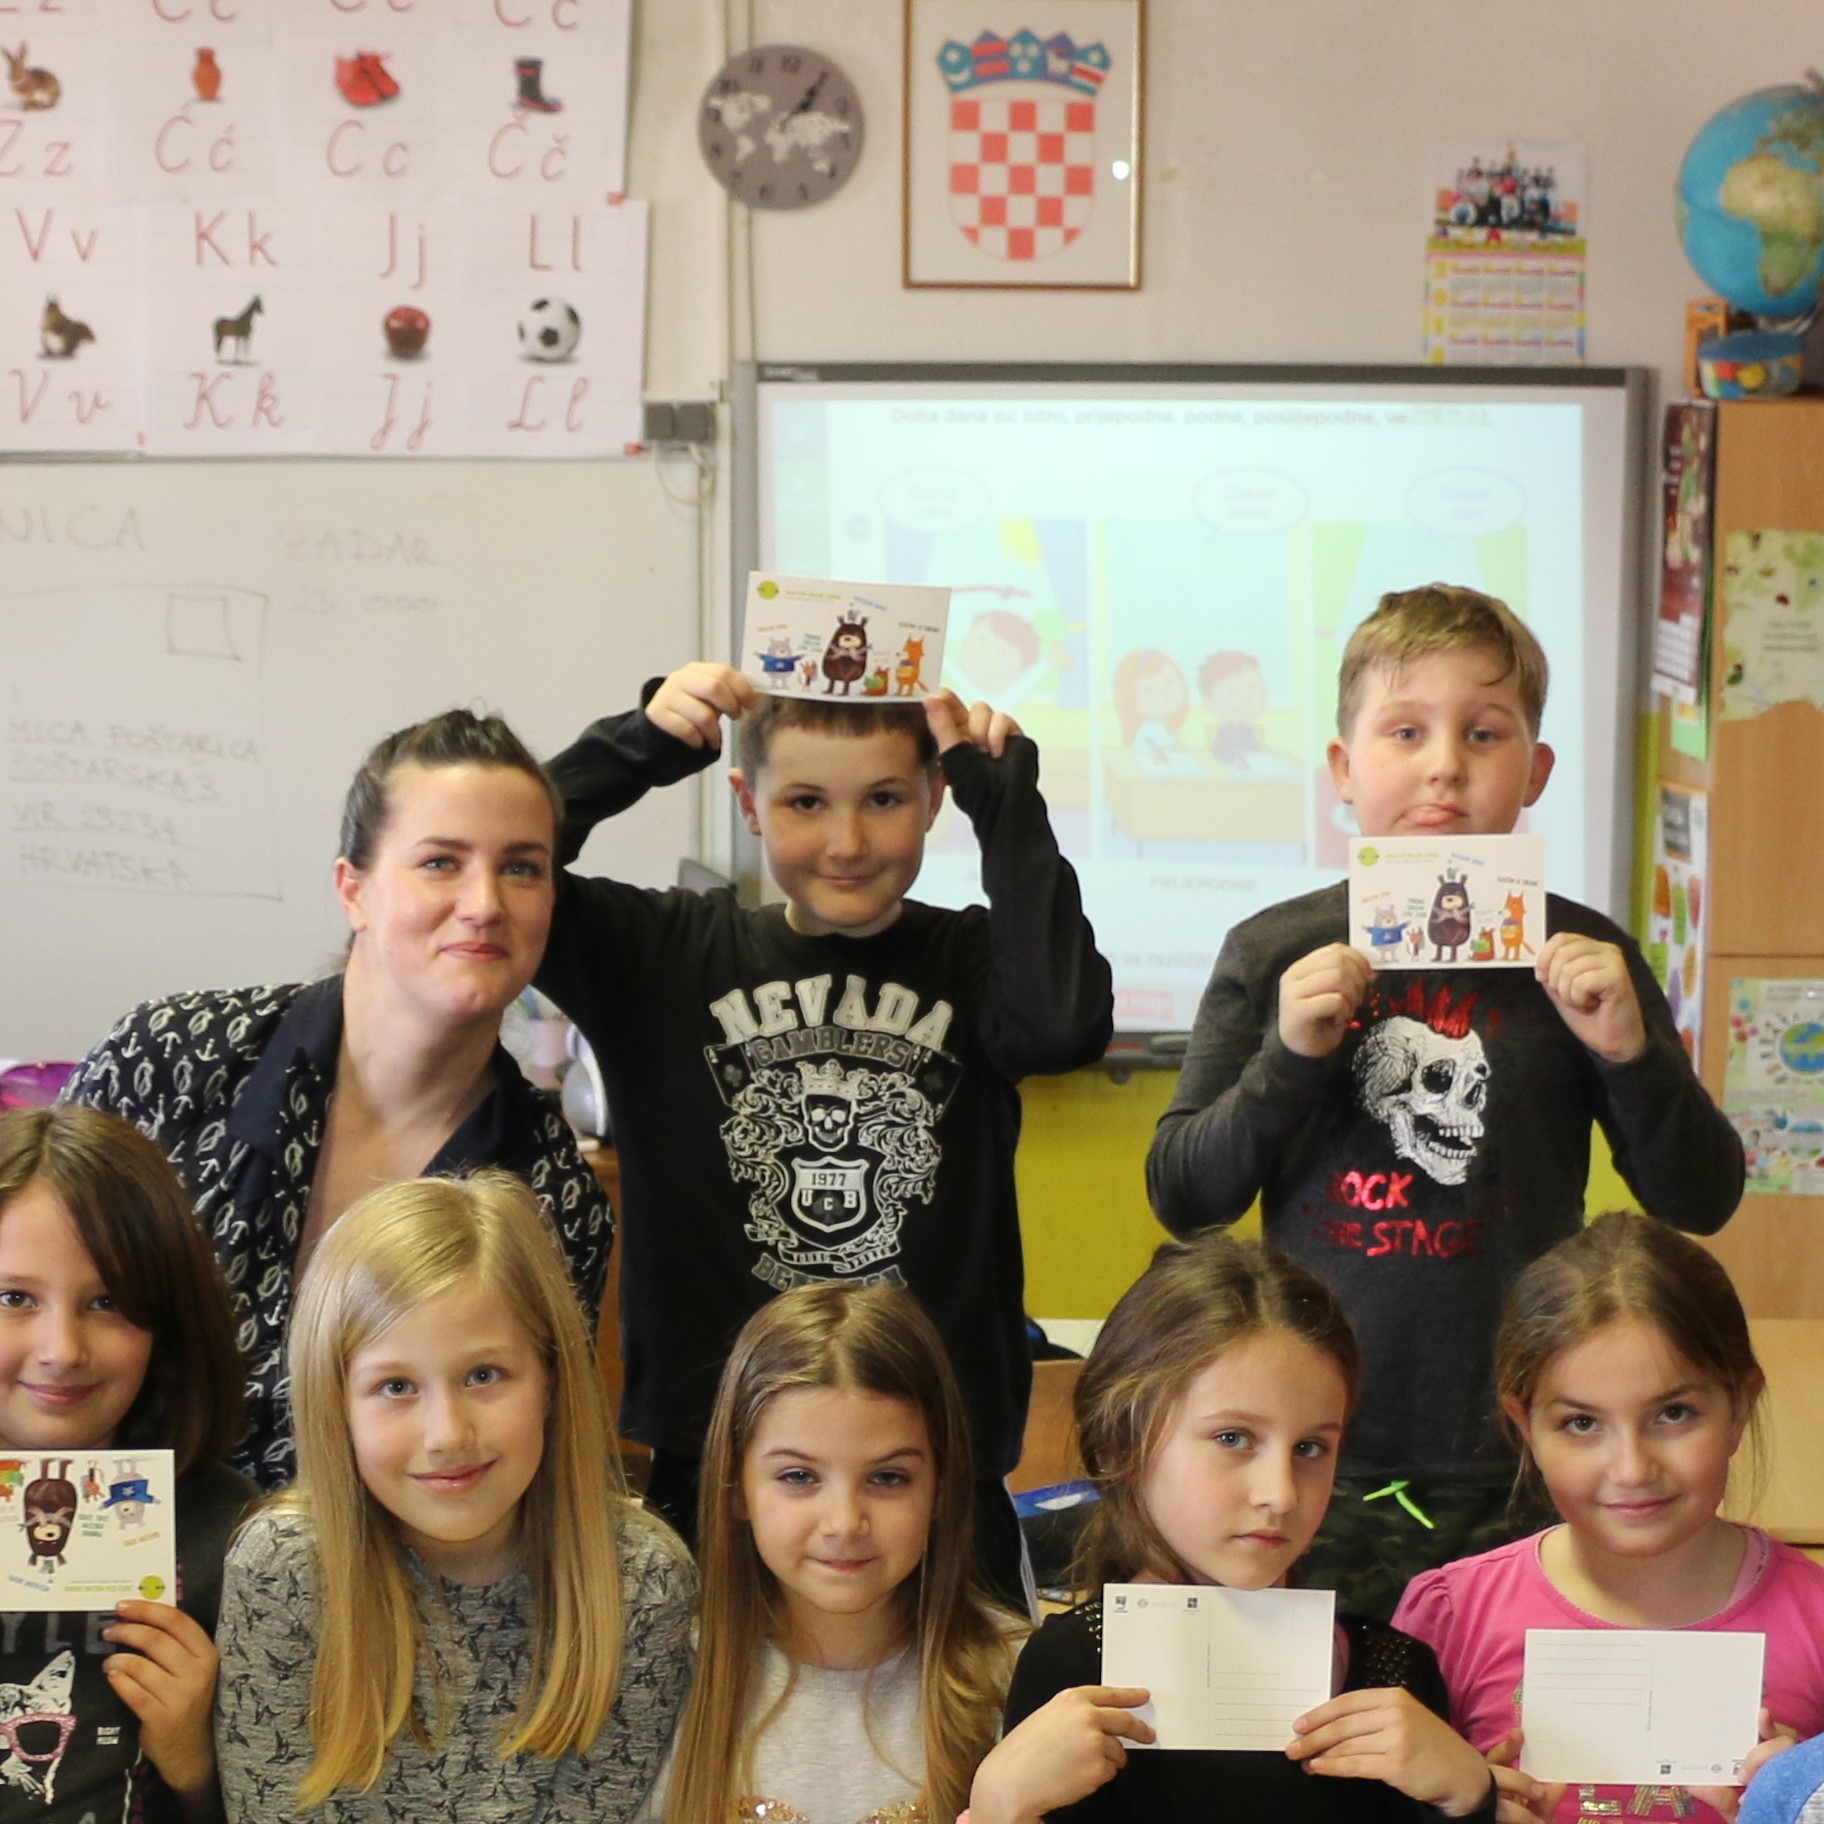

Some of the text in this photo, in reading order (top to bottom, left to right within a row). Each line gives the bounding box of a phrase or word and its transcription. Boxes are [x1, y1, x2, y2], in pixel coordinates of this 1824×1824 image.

[709, 974, 954, 1051] NEVADA
[750, 1025, 914, 1068] GAMBLERS
[811, 1172, 847, 1187] 1977
